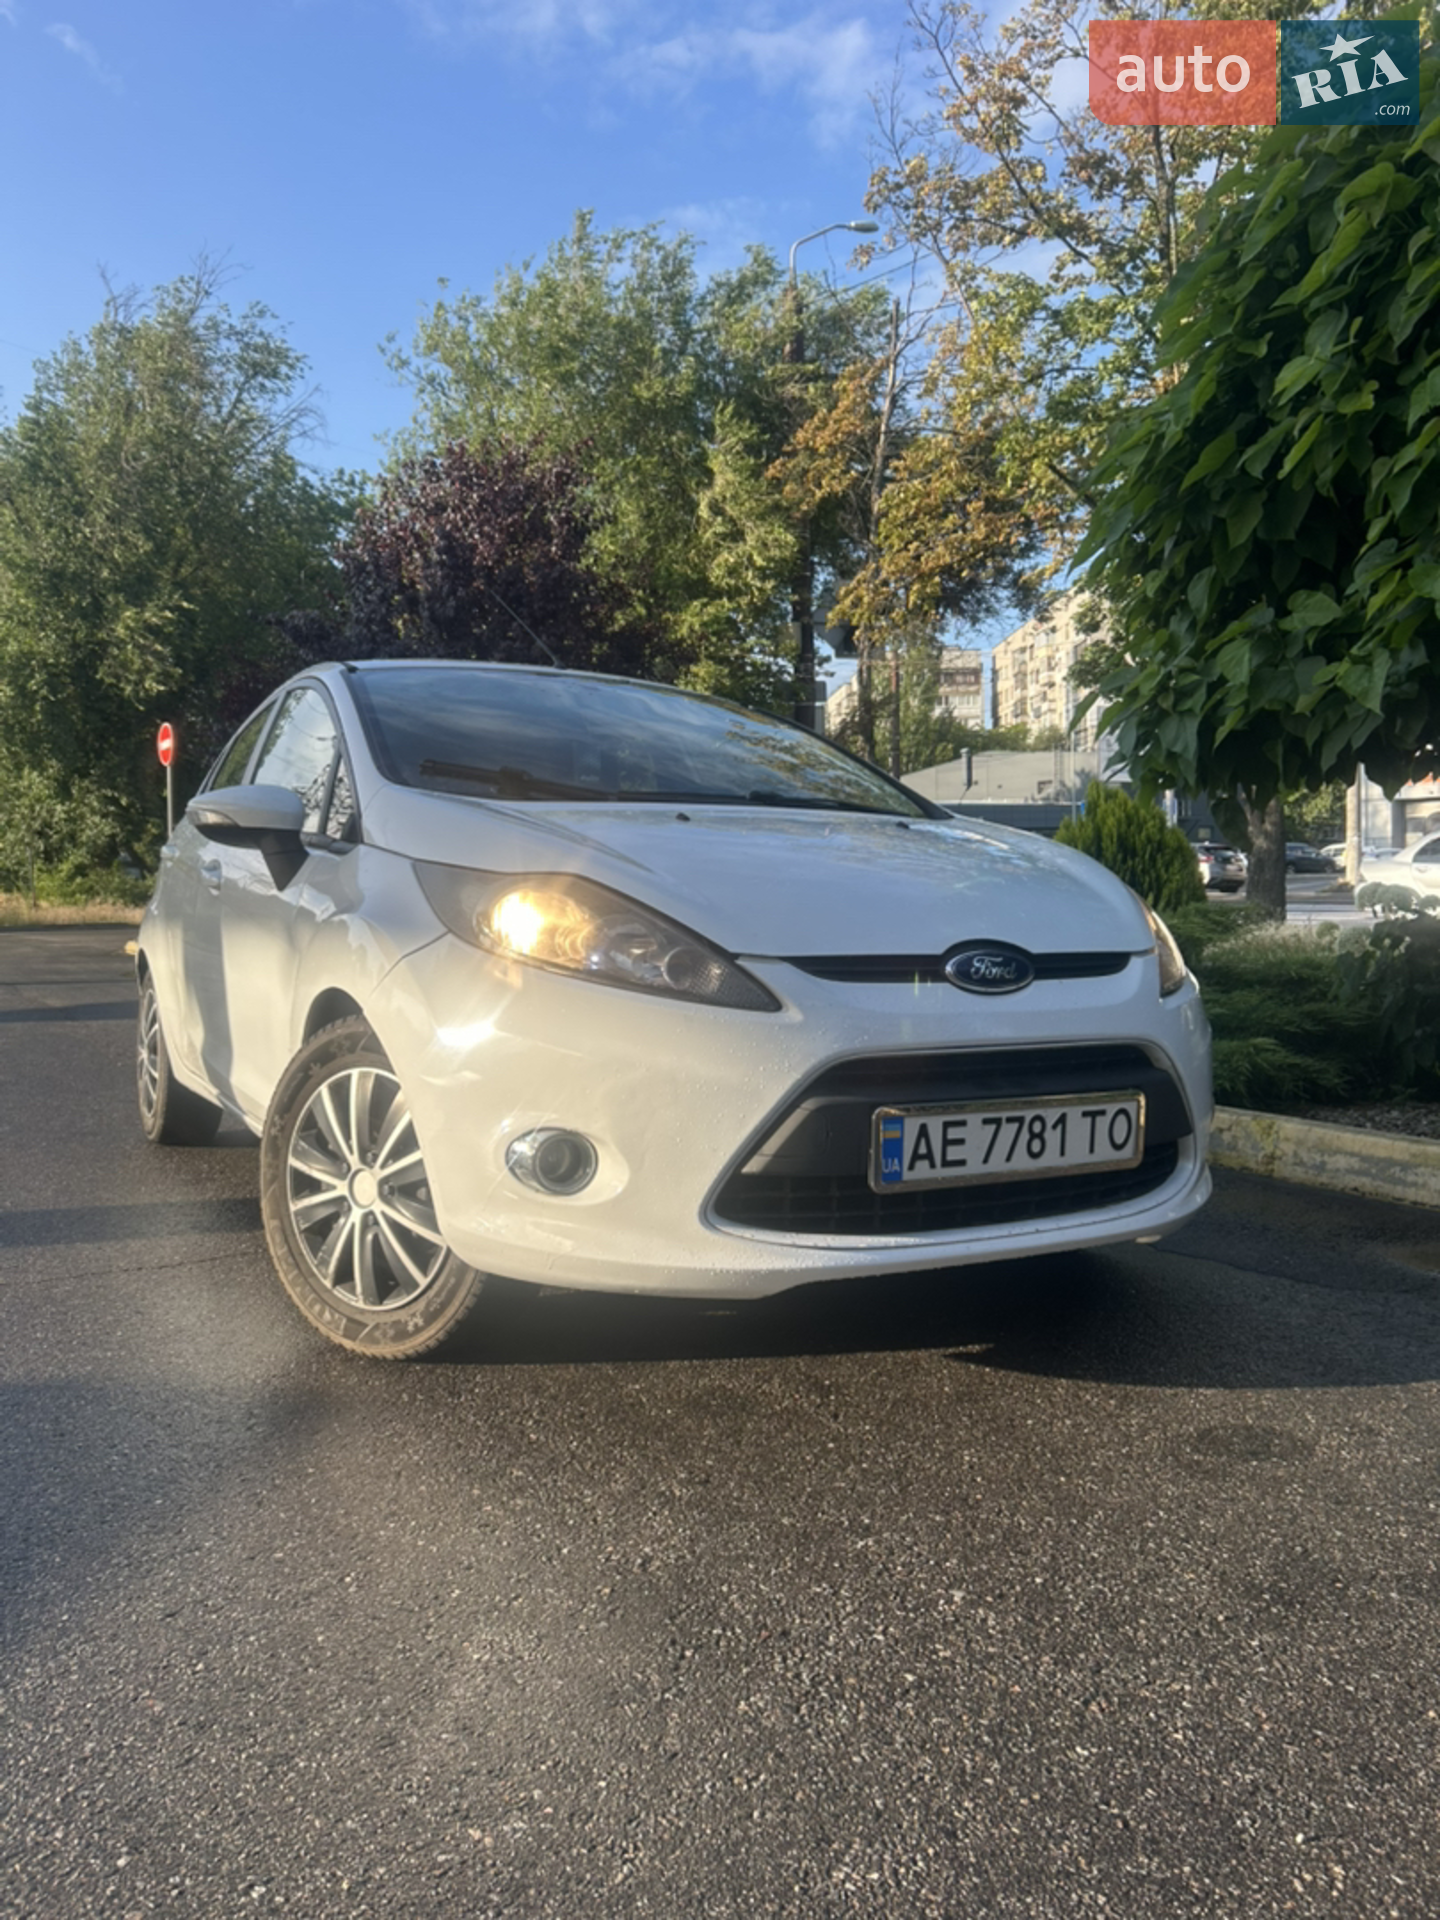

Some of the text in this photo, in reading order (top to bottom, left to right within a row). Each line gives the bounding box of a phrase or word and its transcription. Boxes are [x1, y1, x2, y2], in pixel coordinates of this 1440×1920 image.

[970, 955, 1017, 979] Ford
[907, 1107, 1133, 1172] AE 7781 TO
[881, 1158, 900, 1173] UA
